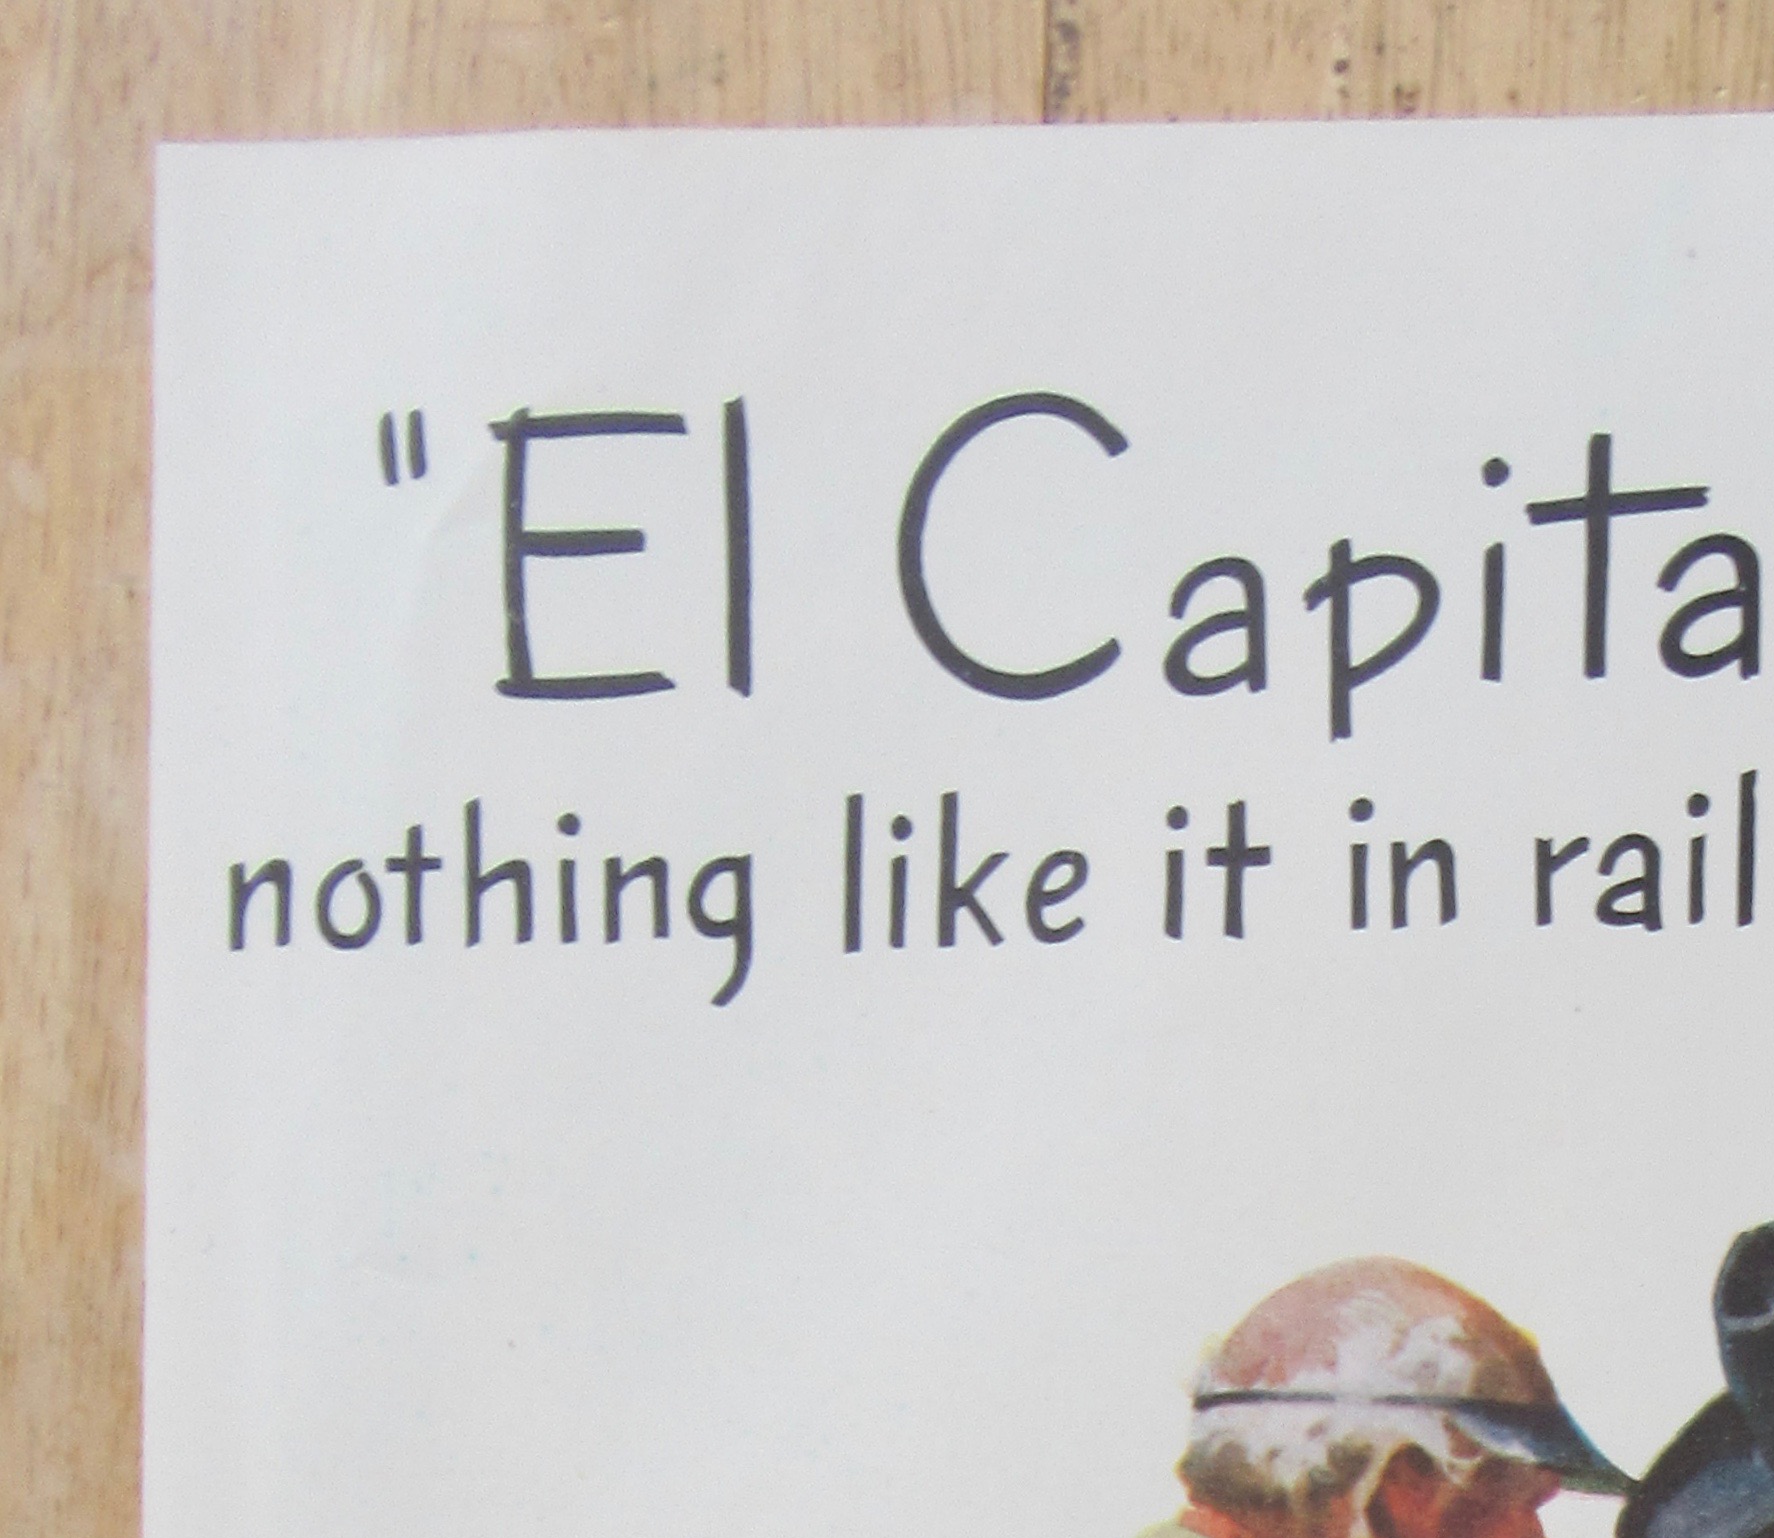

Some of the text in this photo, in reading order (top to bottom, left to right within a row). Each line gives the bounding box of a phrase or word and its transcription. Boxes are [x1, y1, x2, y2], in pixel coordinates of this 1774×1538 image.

[380, 397, 752, 701] "El
[230, 799, 753, 1007] nothing
[844, 791, 1088, 954] like
[1164, 800, 1271, 940] it
[1349, 797, 1457, 930] in
